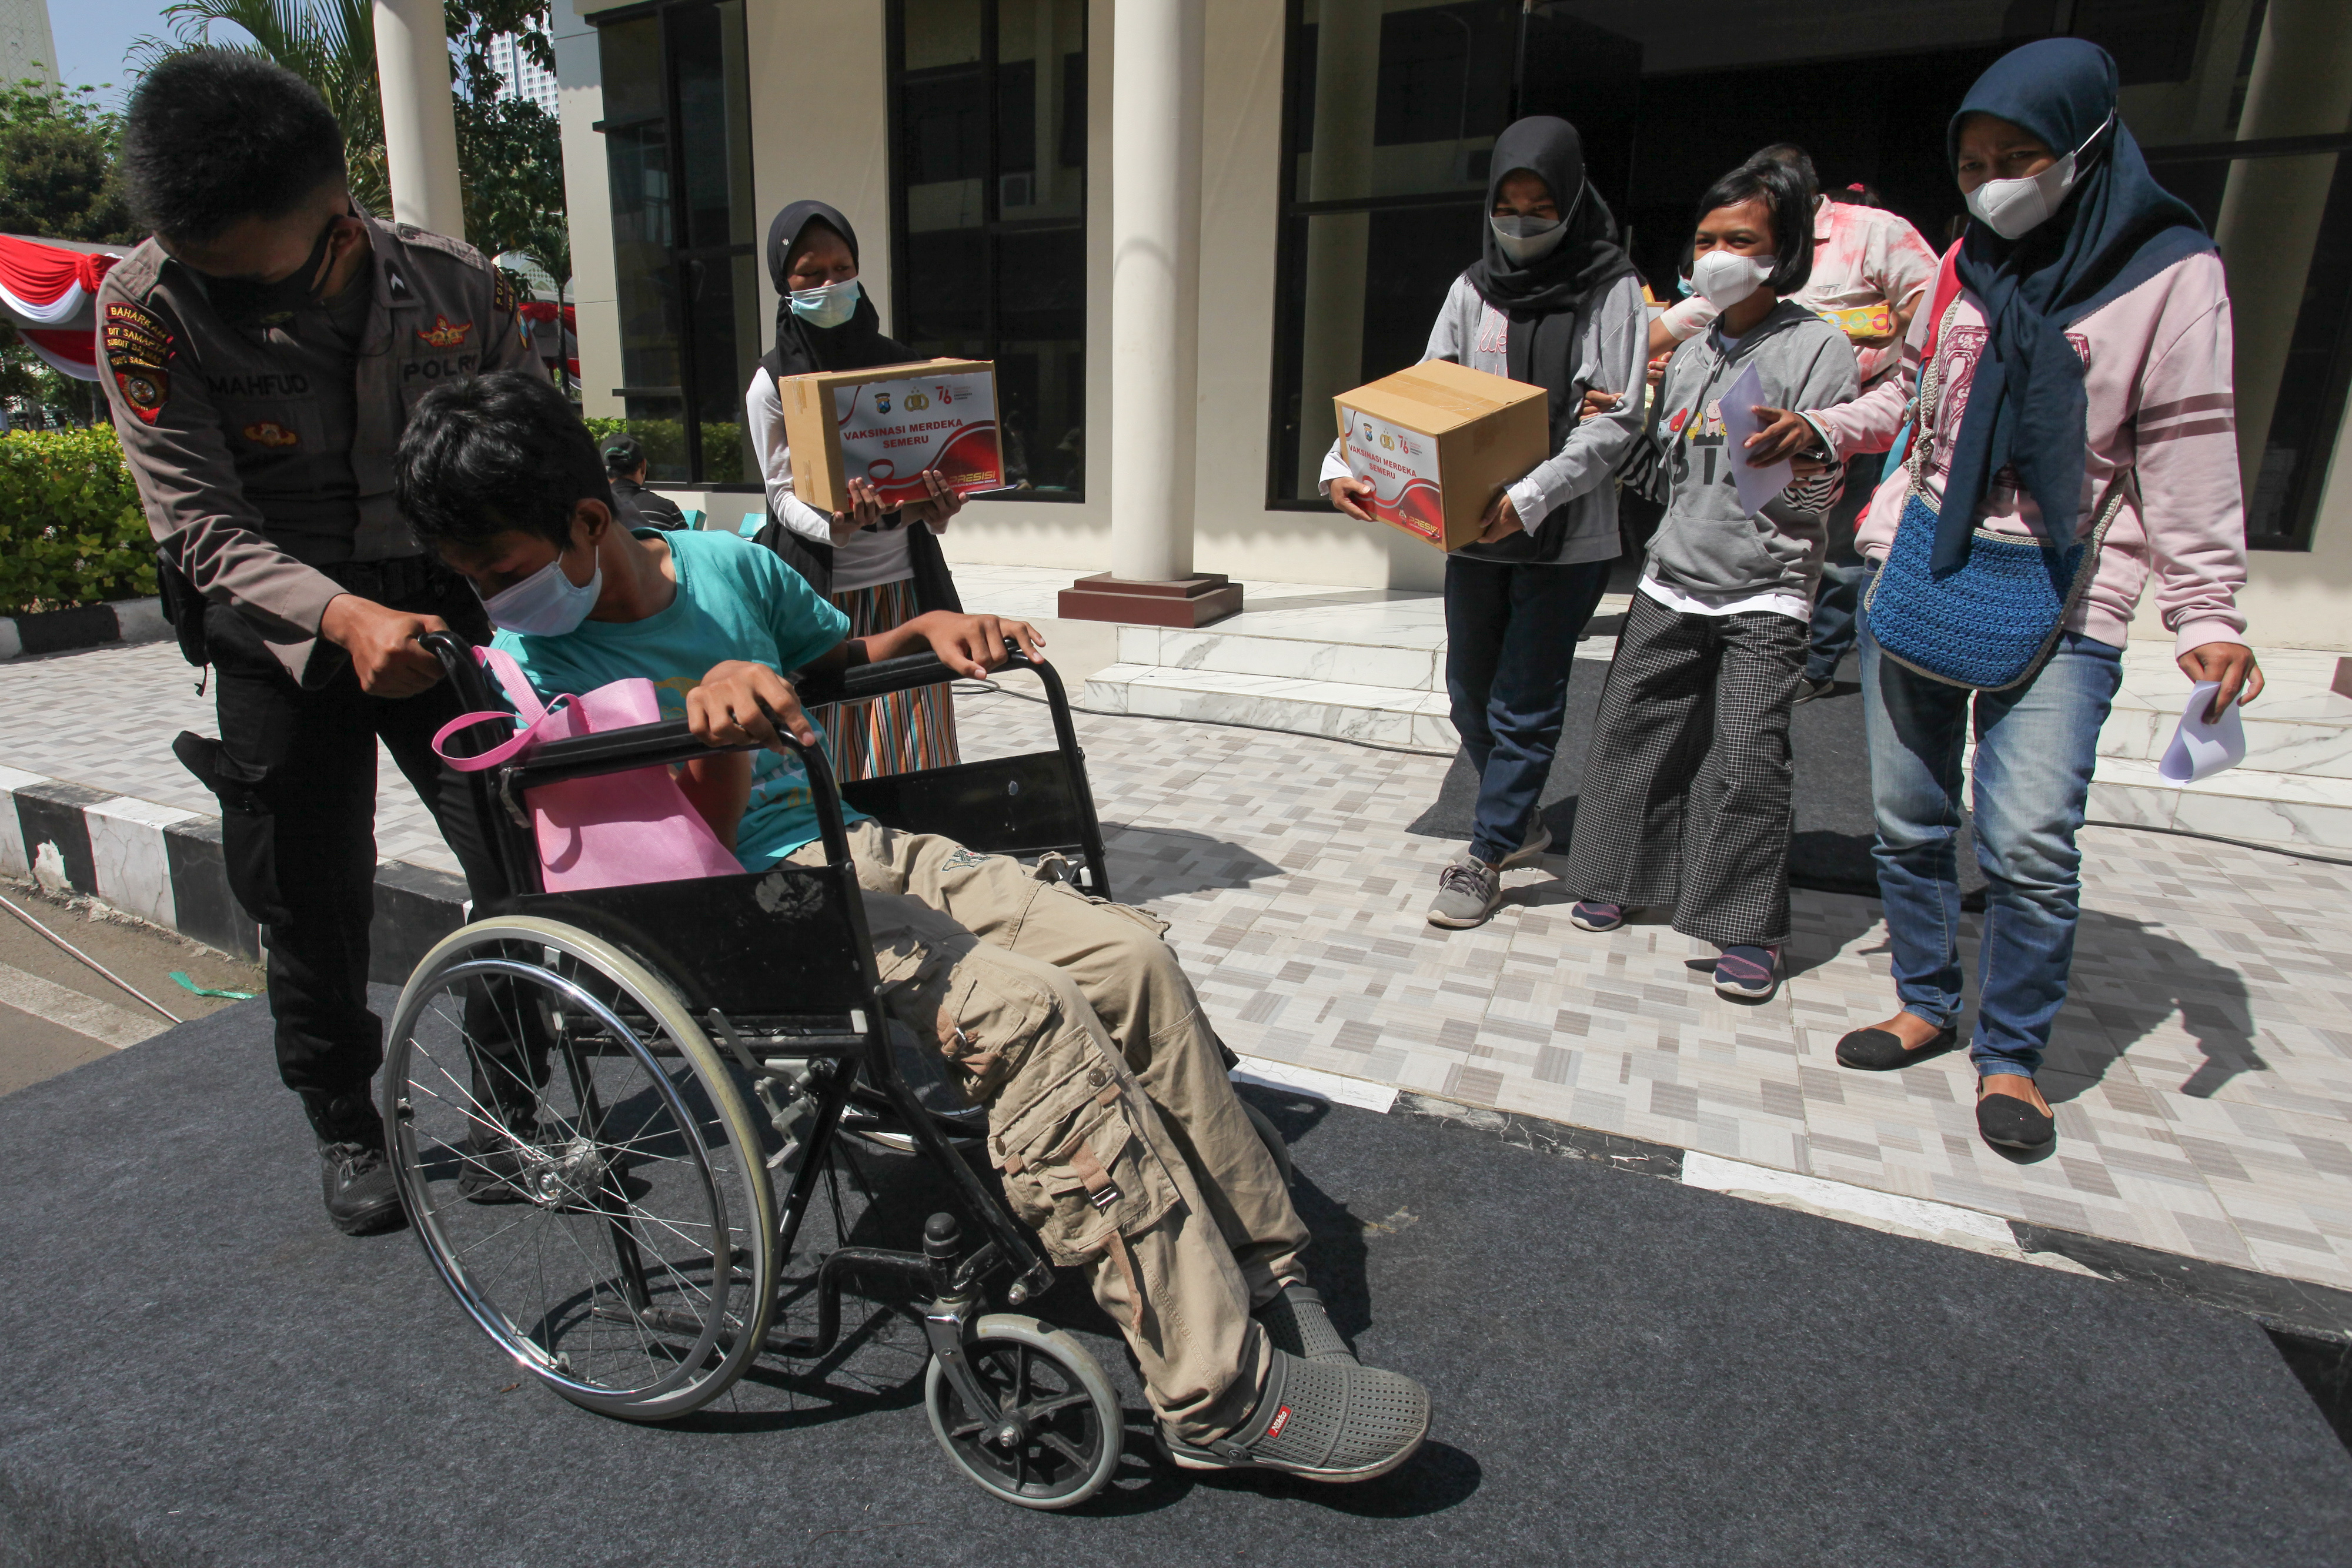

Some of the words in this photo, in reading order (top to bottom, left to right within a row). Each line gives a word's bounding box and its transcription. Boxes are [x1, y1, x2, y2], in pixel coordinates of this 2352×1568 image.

[108, 327, 120, 336] DIT
[110, 307, 167, 339] BAHARKAM
[1475, 310, 1509, 353] lik
[403, 355, 477, 382] POLRI
[206, 373, 309, 396] MAHFUD
[936, 385, 952, 404] 76
[843, 425, 906, 440] VAKSINASI
[909, 419, 964, 433] MERDEKA
[883, 435, 929, 449] SEMERU
[1348, 444, 1382, 463] VAKSINASI
[1383, 458, 1417, 477] MERDEKA
[1369, 463, 1396, 479] SEMERU
[948, 471, 996, 484] PRESISI
